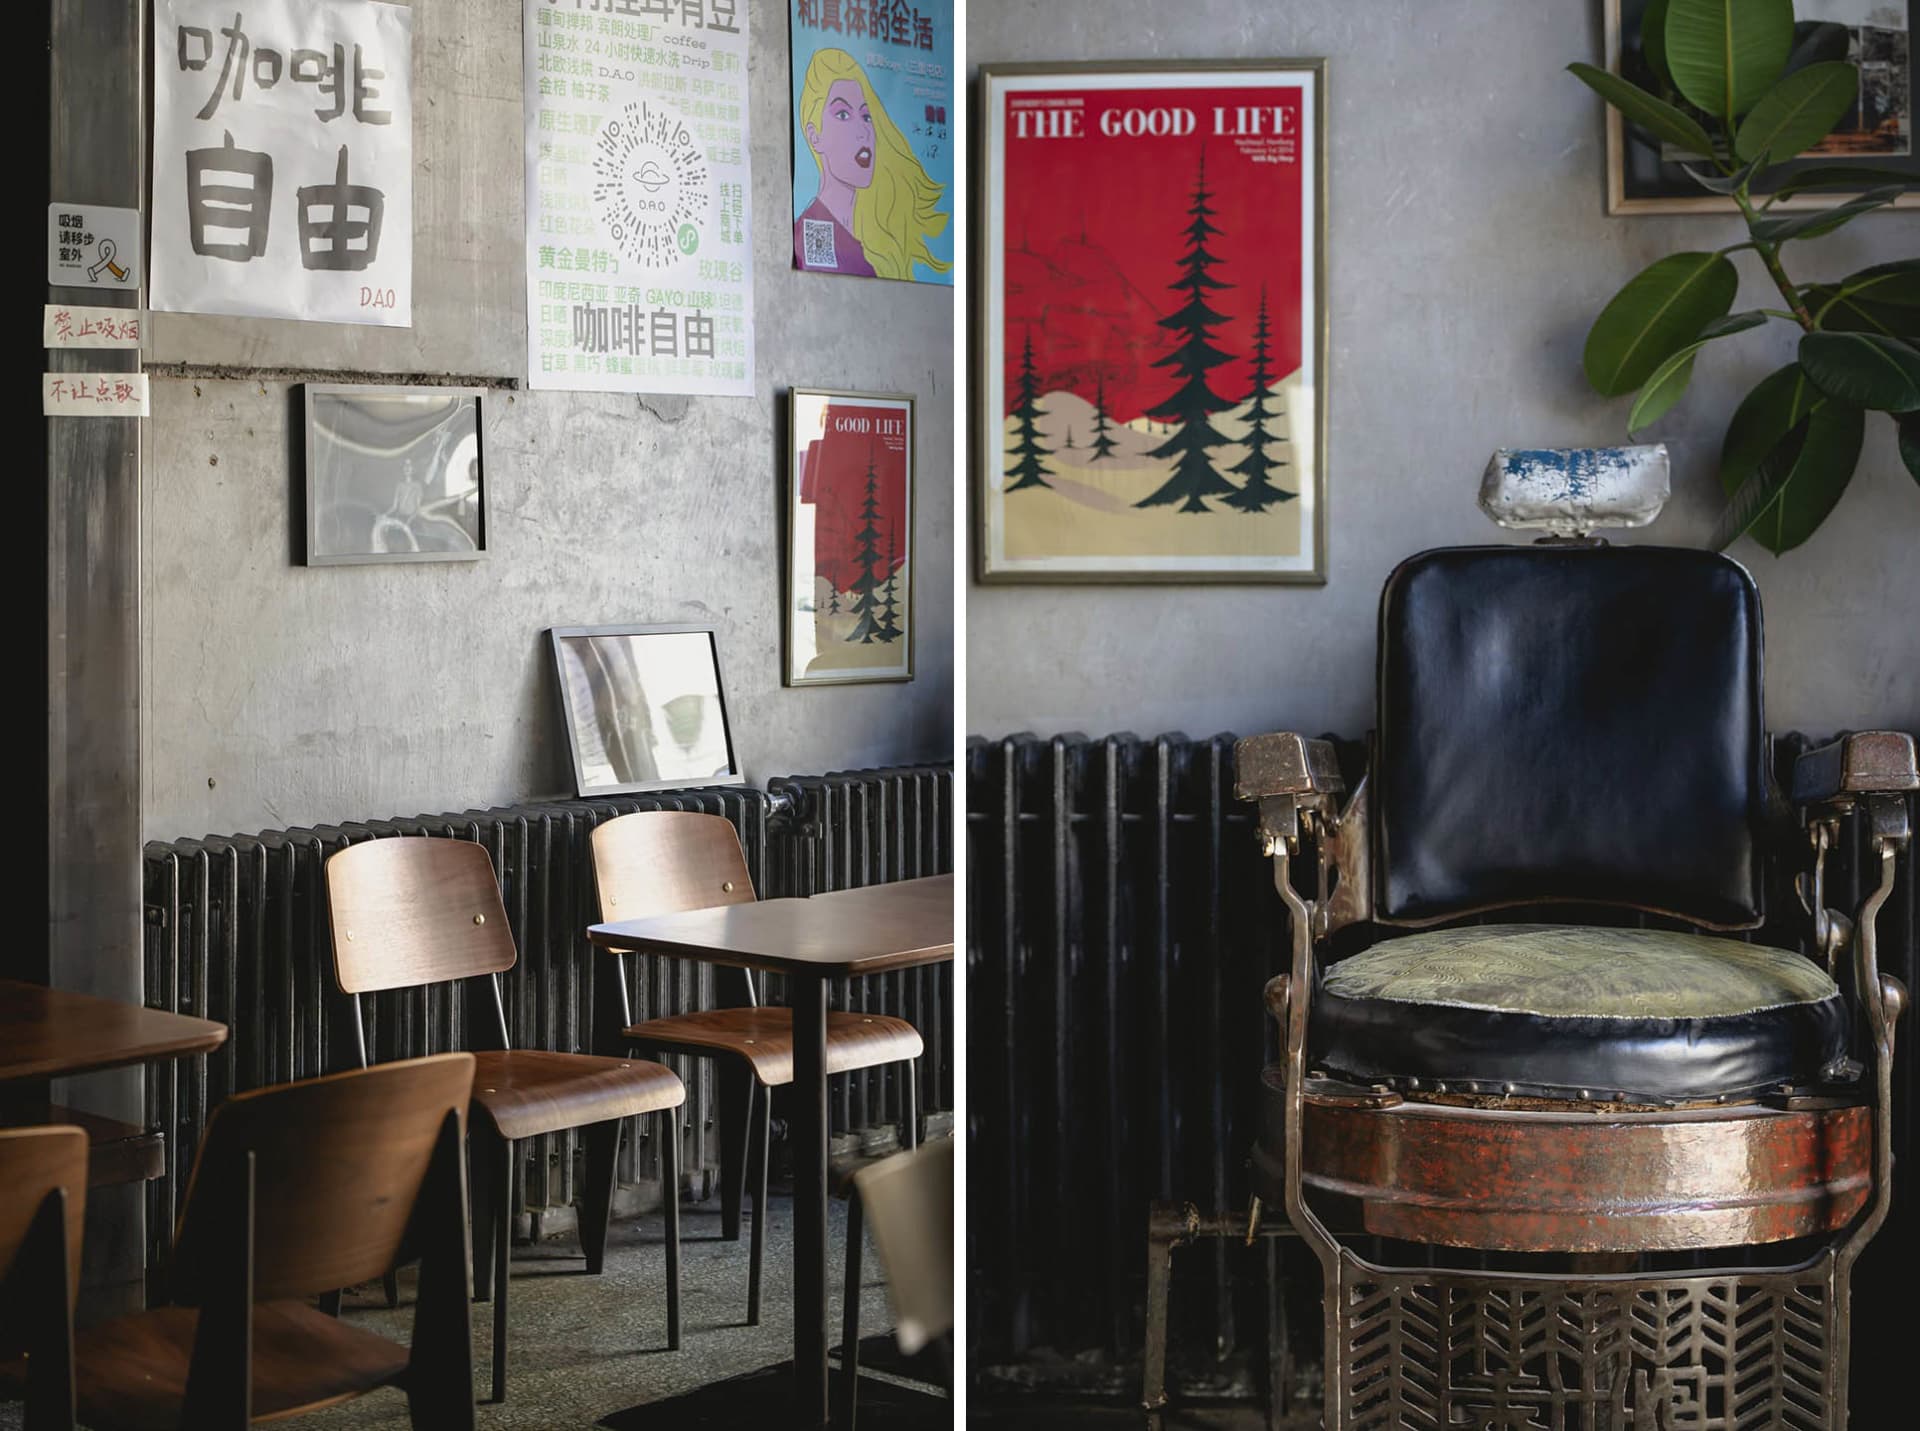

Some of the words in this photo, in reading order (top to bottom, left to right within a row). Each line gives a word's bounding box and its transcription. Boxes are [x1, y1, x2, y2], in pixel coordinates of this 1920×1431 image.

[537, 31, 580, 53] 山泉水
[585, 39, 601, 54] 24
[663, 34, 708, 50] coffee
[178, 12, 393, 124] 咖啡
[599, 66, 636, 81] D.A.O
[682, 54, 711, 70] Drip
[1010, 110, 1085, 138] THE
[1099, 108, 1197, 137] GOOD
[1213, 106, 1295, 135] LIFE
[186, 129, 386, 271] 自由
[58, 214, 84, 229] 吸烟
[58, 230, 95, 246] 请移步
[58, 247, 83, 262] 室外
[538, 280, 609, 304] 印度尼西亚
[646, 288, 684, 306] GAYO
[54, 309, 140, 341] 禁止吸烟
[572, 302, 716, 359] 咖啡自由
[50, 378, 141, 403] 不让点歌
[835, 416, 871, 433] GOOD
